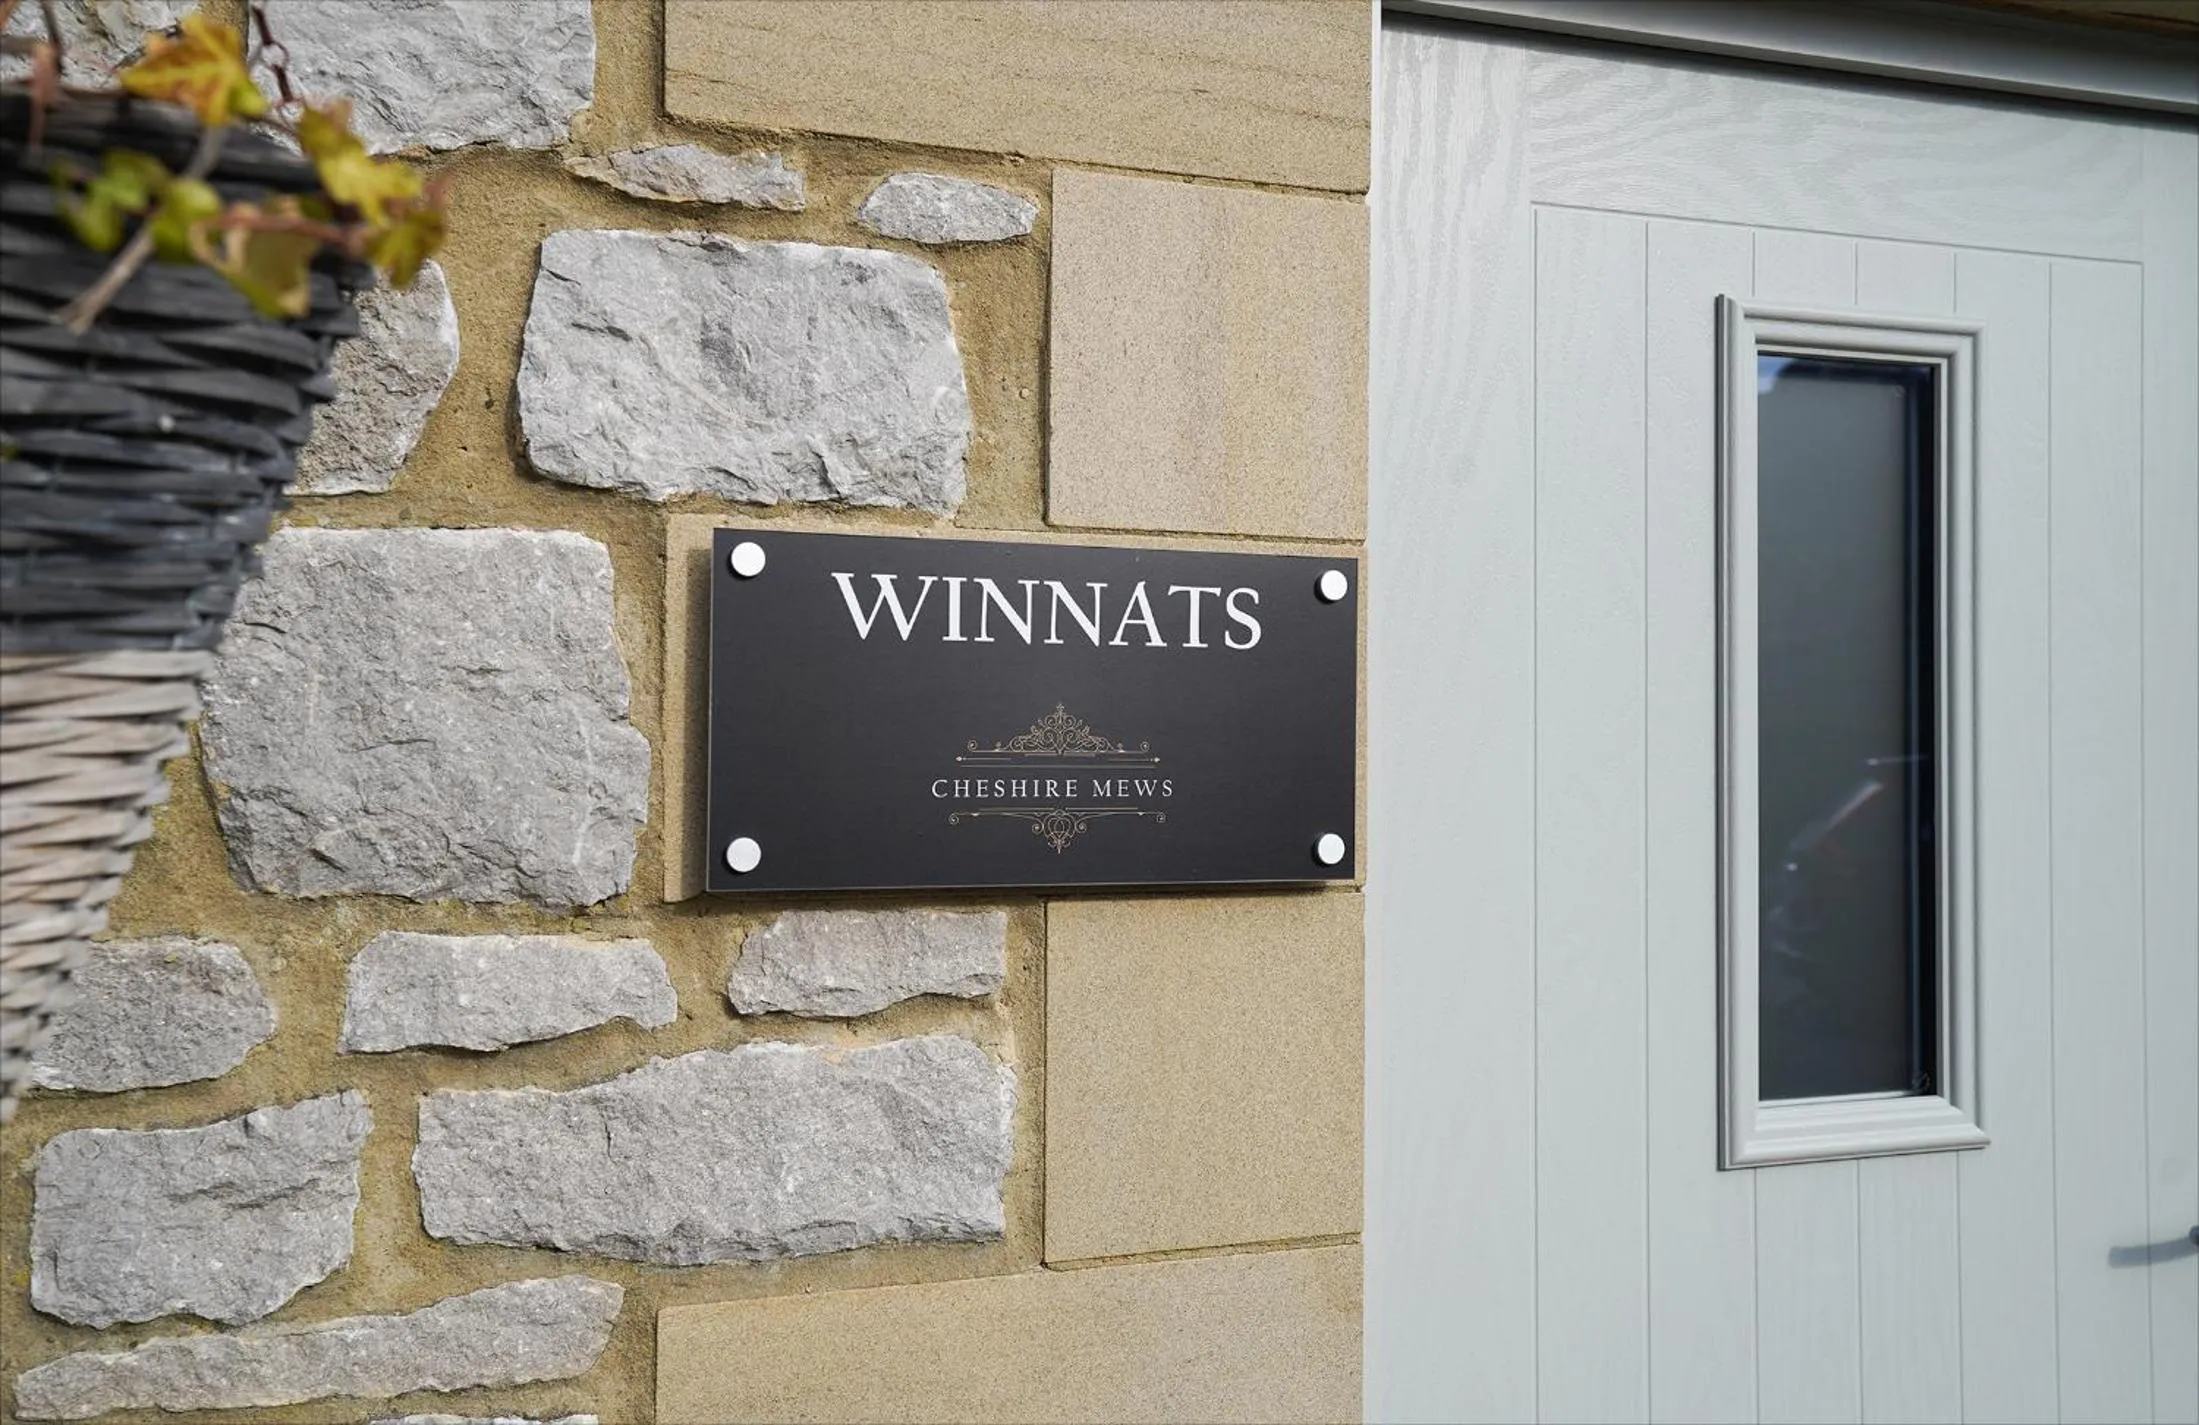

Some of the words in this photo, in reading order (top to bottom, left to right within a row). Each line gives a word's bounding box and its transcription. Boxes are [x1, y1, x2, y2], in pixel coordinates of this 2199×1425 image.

[831, 572, 1262, 650] WINNATS
[931, 779, 1078, 798] CHESHIRE
[1092, 779, 1174, 798] MEWS
